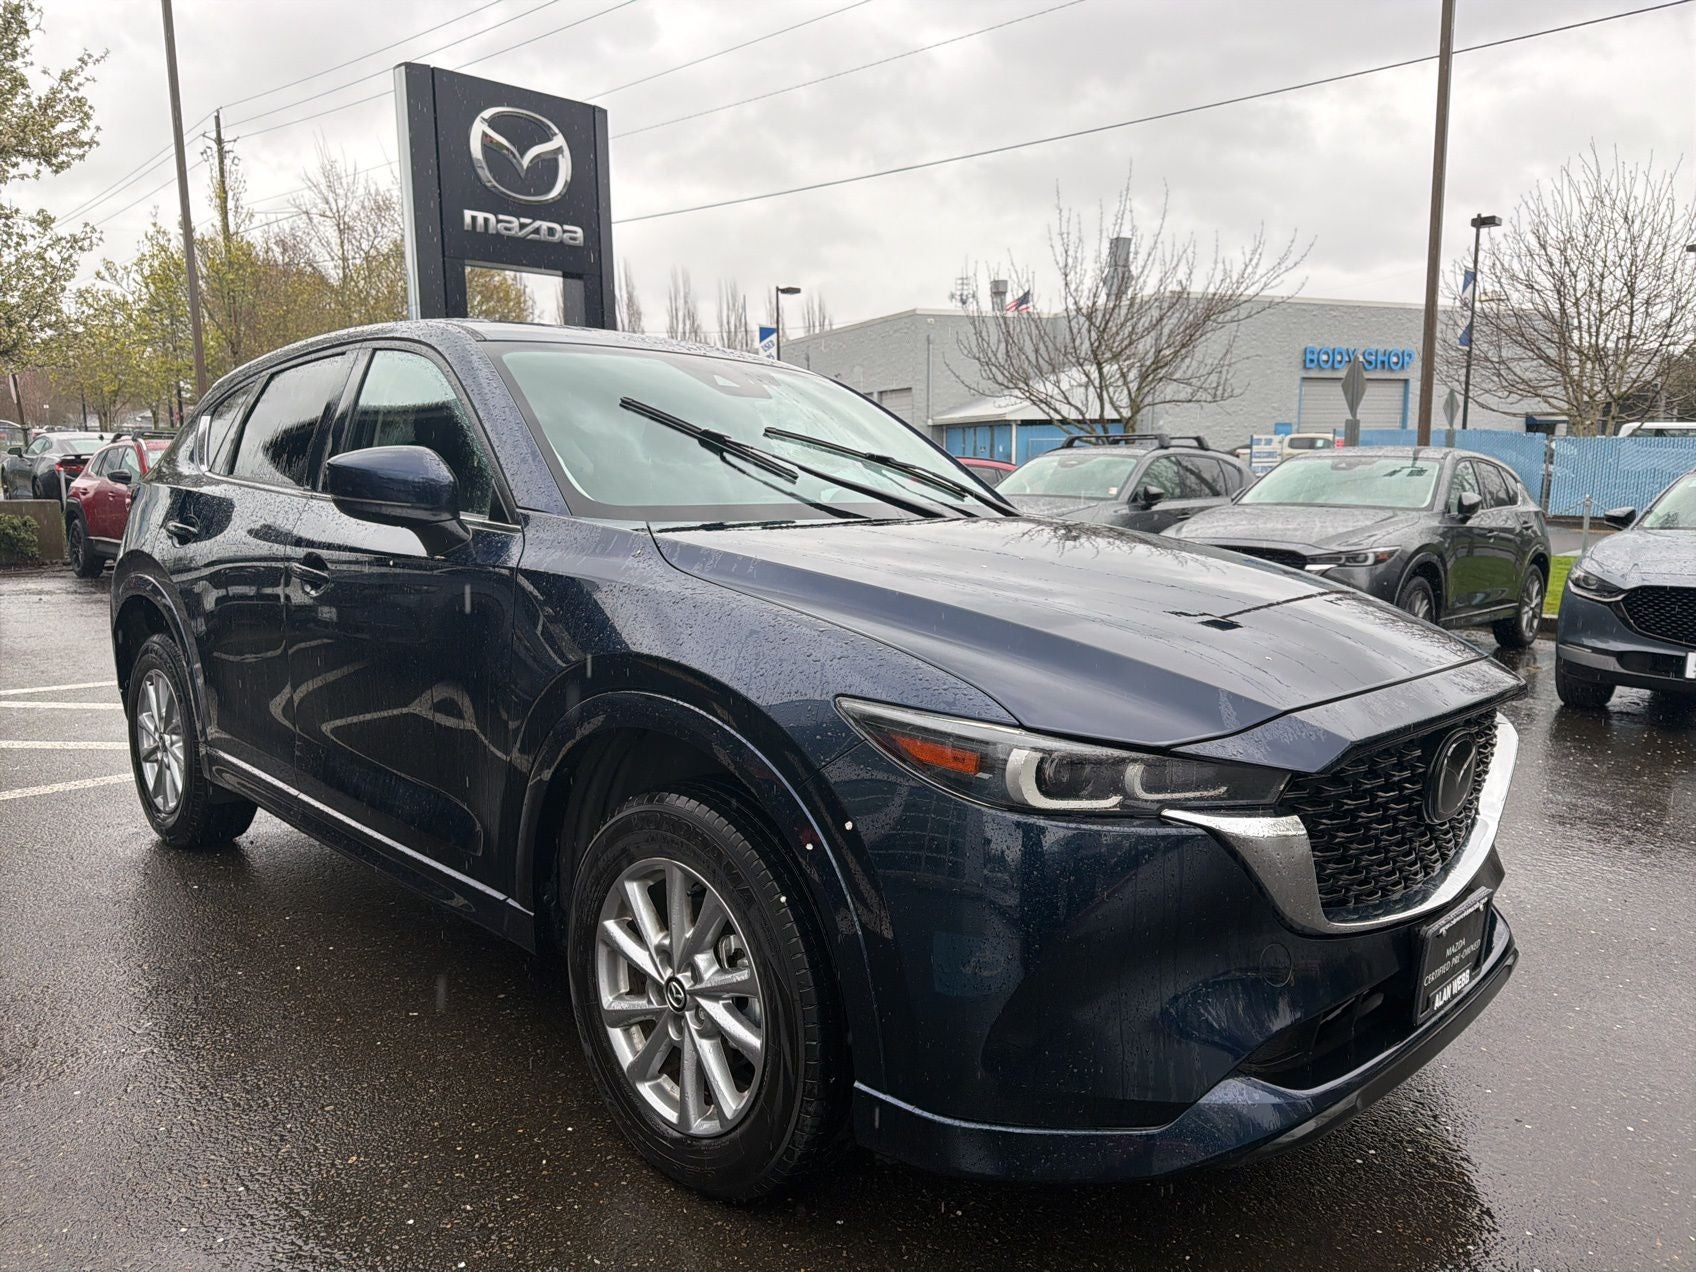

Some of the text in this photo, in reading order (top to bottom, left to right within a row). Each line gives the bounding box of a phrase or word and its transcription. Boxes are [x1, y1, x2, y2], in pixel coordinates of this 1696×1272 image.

[1304, 346, 1416, 371] BODY SHOP
[1424, 939, 1481, 987] CERTIFIED PRE-OWNED
[1445, 937, 1466, 958] MAZDA
[1433, 969, 1470, 1010] ALAN WEBB
